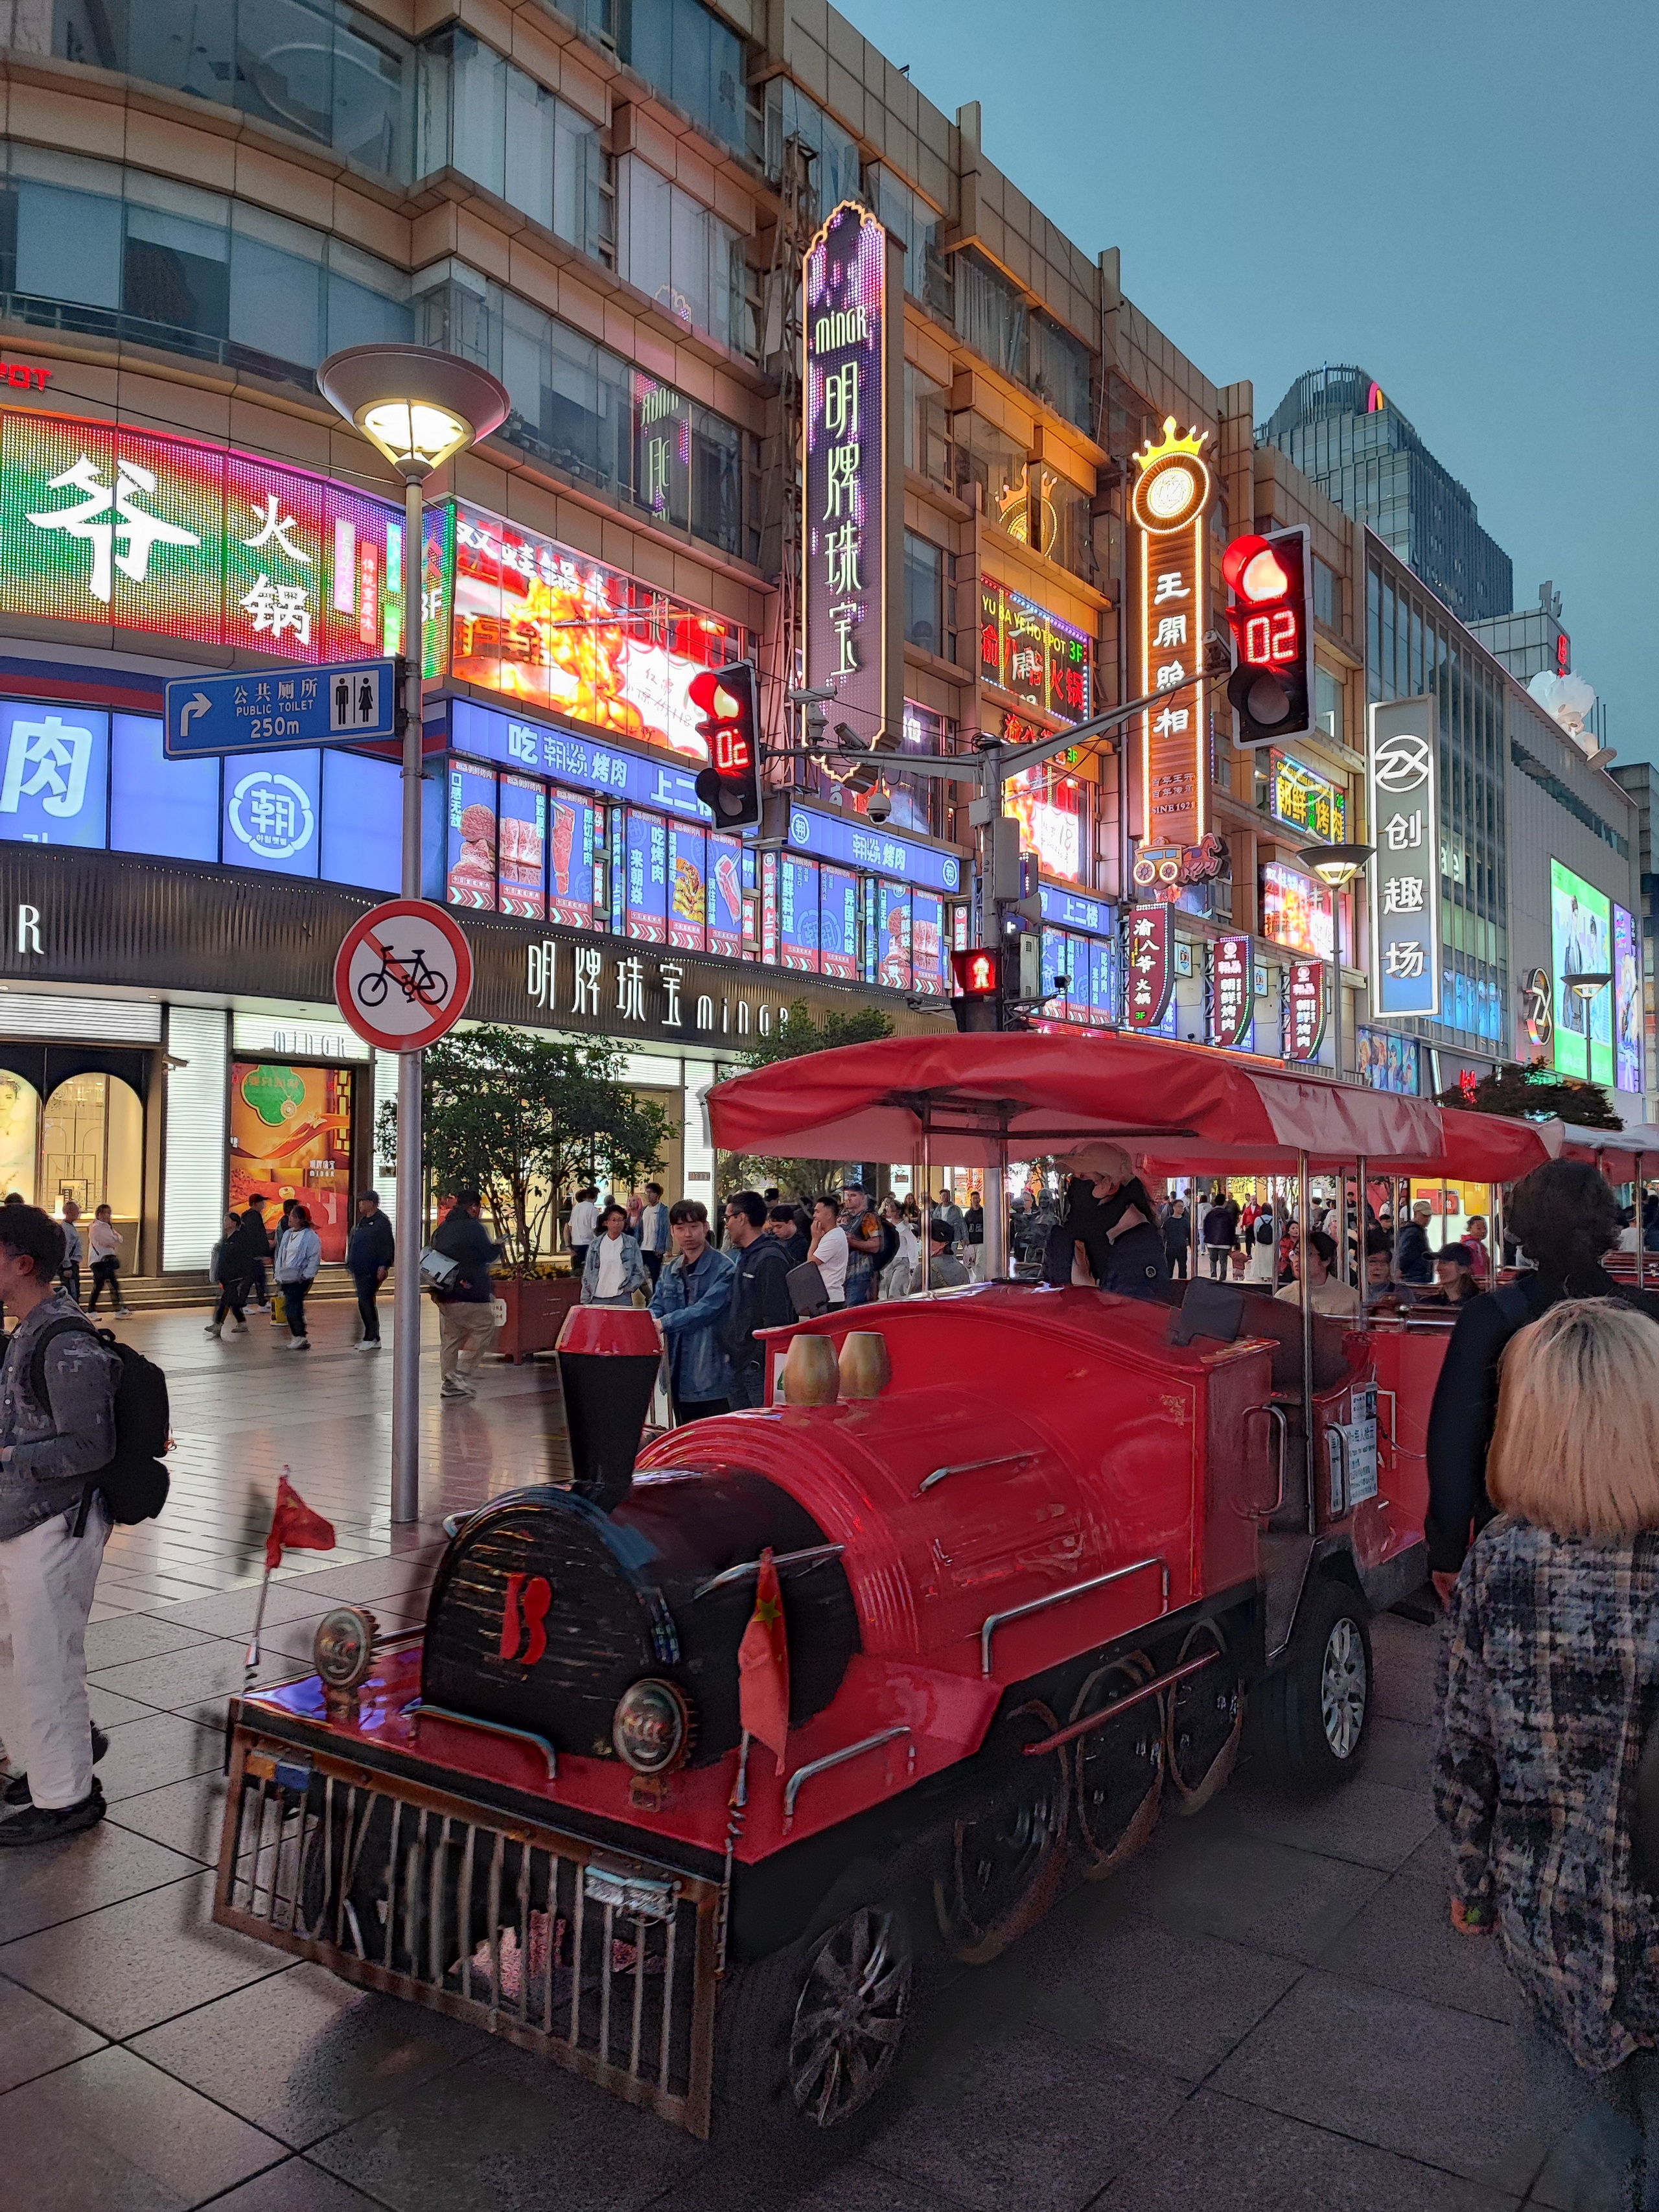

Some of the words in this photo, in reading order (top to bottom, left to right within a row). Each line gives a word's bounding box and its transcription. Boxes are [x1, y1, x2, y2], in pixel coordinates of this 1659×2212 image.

[25, 452, 201, 603] 爷
[822, 360, 862, 676] 明牌珠宝
[241, 494, 312, 646] 火锅
[982, 594, 996, 615] YU
[1069, 640, 1083, 662] 3F
[1246, 610, 1296, 664] 02
[233, 677, 318, 704] 公共厕所
[236, 704, 272, 717] PUBLIC
[279, 699, 314, 712] TOILET
[251, 716, 299, 738] 250m
[1, 715, 93, 818] 肉
[450, 772, 462, 828] 口感无敌
[651, 826, 664, 884] 吃烤肉
[844, 887, 855, 955] 异国风味
[1063, 898, 1098, 929] 上二楼
[1383, 809, 1424, 978] 创趣场
[528, 940, 684, 1026] 明牌珠宝
